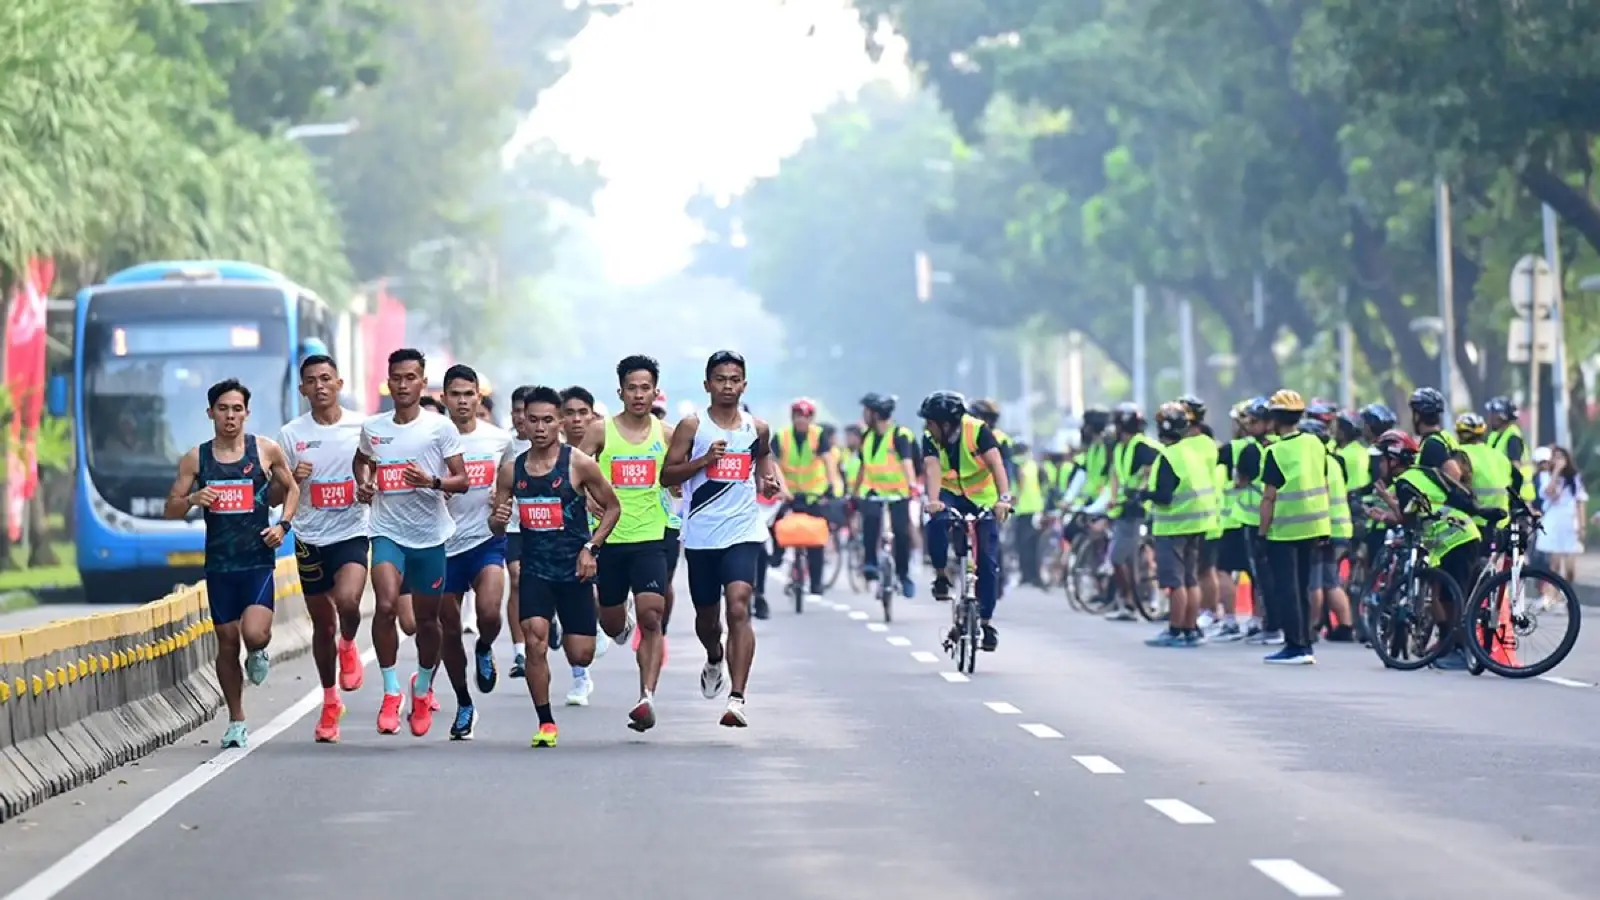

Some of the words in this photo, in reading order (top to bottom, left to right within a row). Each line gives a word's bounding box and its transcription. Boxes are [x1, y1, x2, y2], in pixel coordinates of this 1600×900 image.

[465, 463, 486, 478] 222
[621, 463, 648, 477] 11834
[716, 457, 742, 470] 11083
[382, 468, 404, 482] 1007
[320, 486, 346, 499] 12741
[527, 506, 551, 520] 11601
